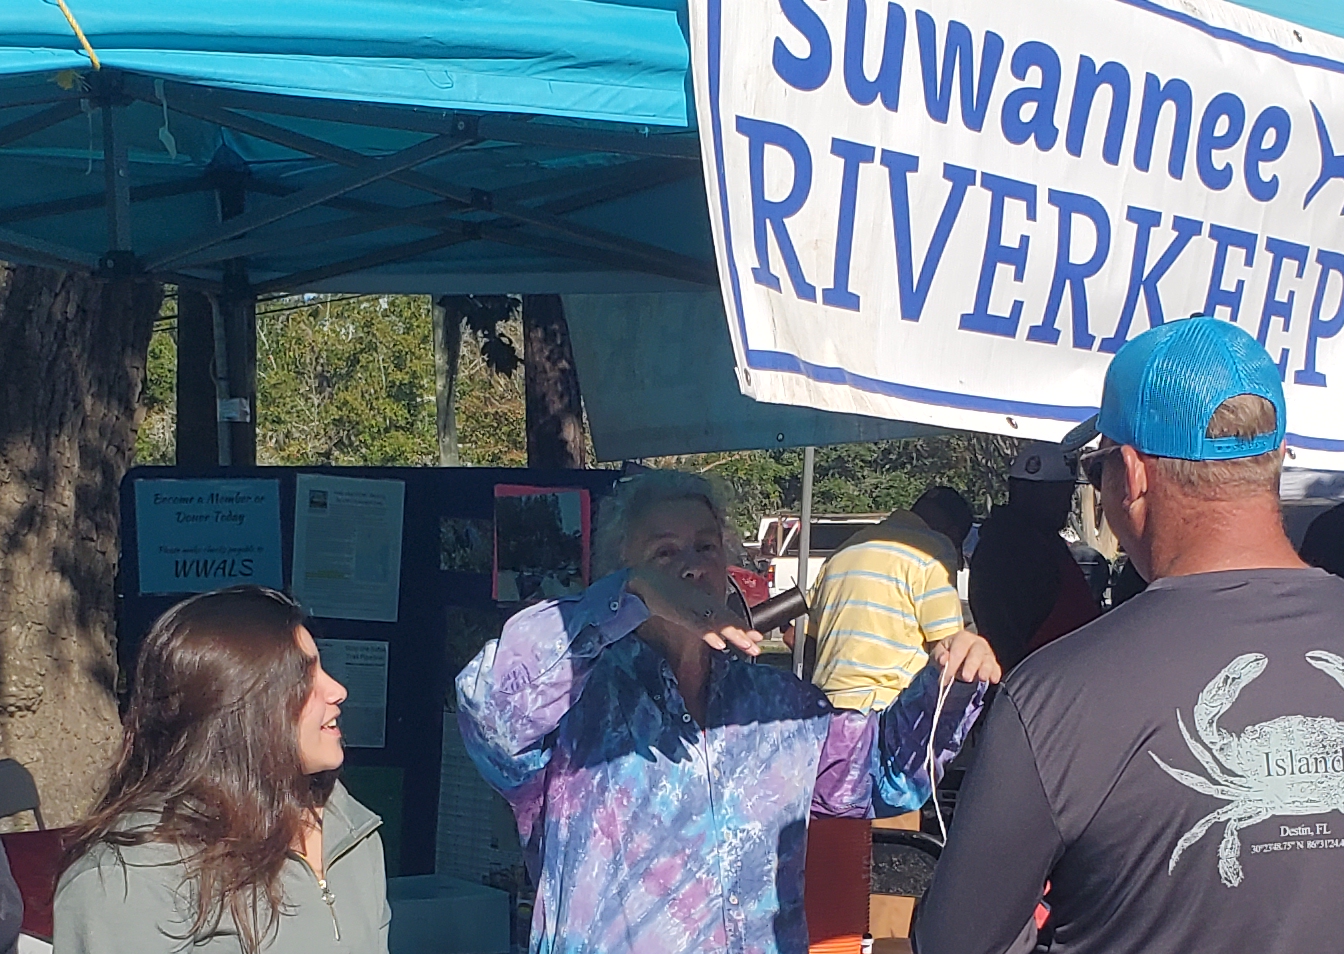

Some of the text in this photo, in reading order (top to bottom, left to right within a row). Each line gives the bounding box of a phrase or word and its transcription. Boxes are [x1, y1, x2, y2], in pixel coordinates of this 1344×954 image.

[771, 0, 1293, 203] Suwannee
[174, 558, 255, 578] WWALS
[1315, 823, 1332, 835] FL
